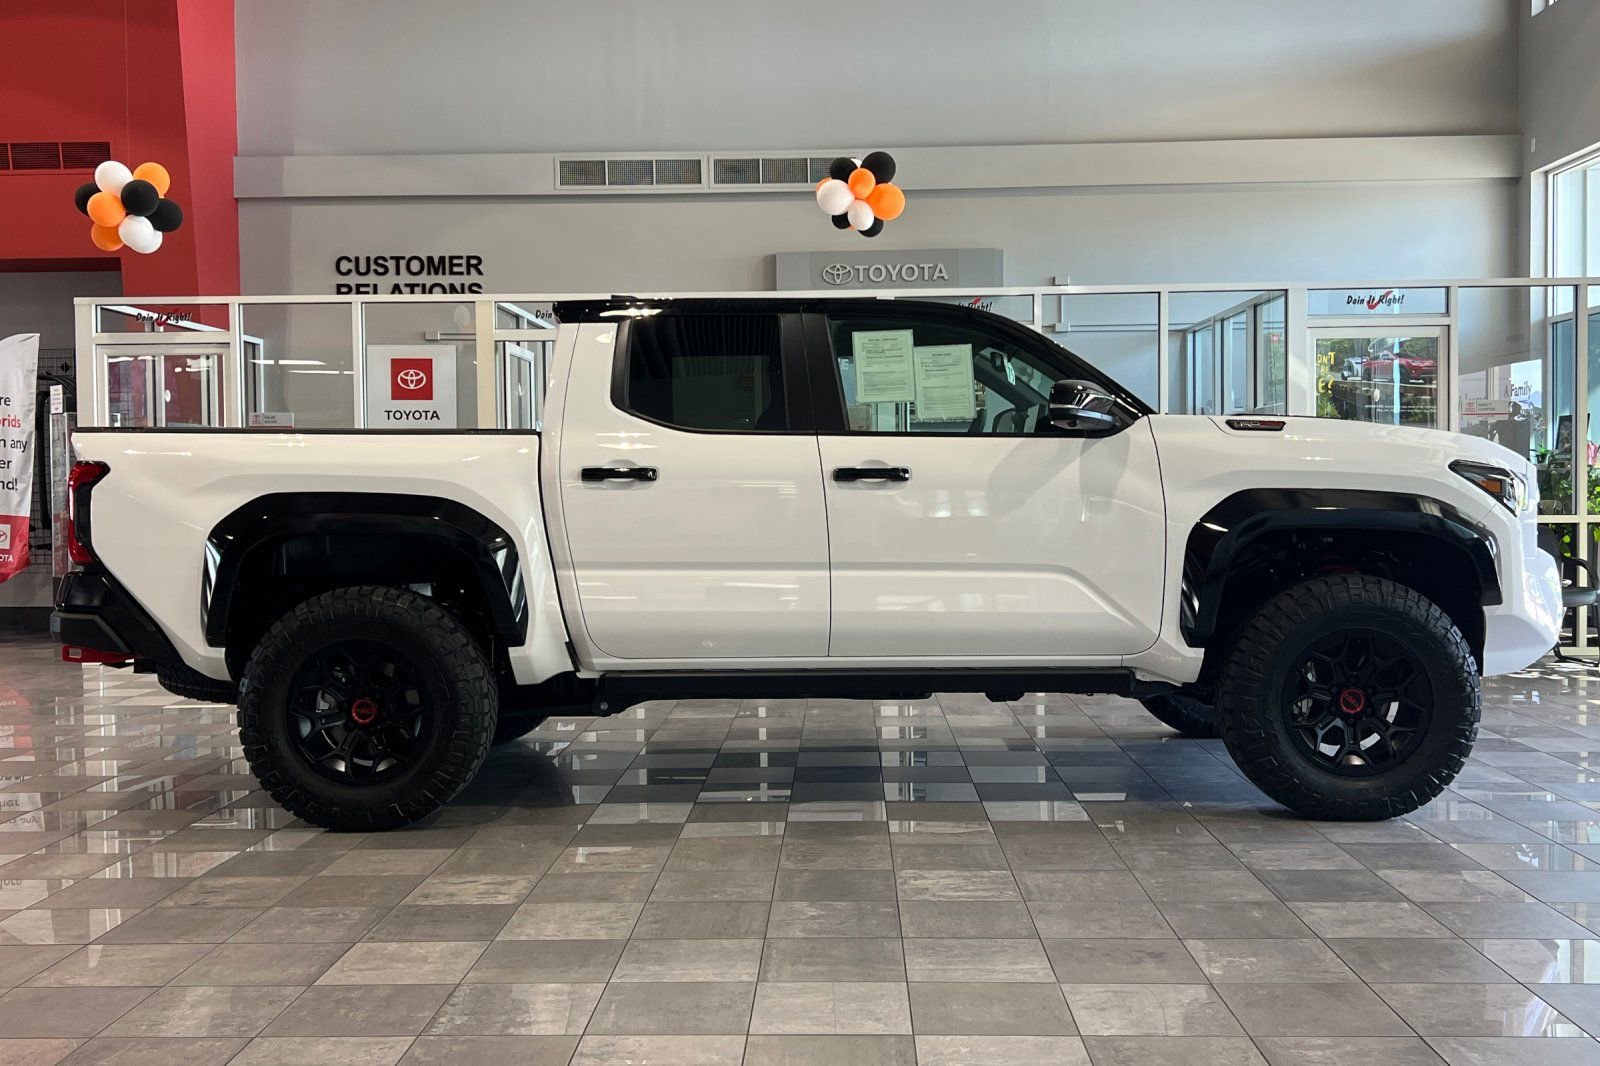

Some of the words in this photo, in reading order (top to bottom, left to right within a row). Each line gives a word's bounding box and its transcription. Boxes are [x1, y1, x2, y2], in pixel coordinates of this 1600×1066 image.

[335, 255, 484, 276] CUSTOMER
[855, 263, 949, 282] TOYOTA
[1379, 294, 1405, 307] Right!
[1510, 381, 1533, 400] Family
[0, 414, 21, 428] rids
[384, 410, 441, 421] TOYOTA
[10, 439, 28, 453] any
